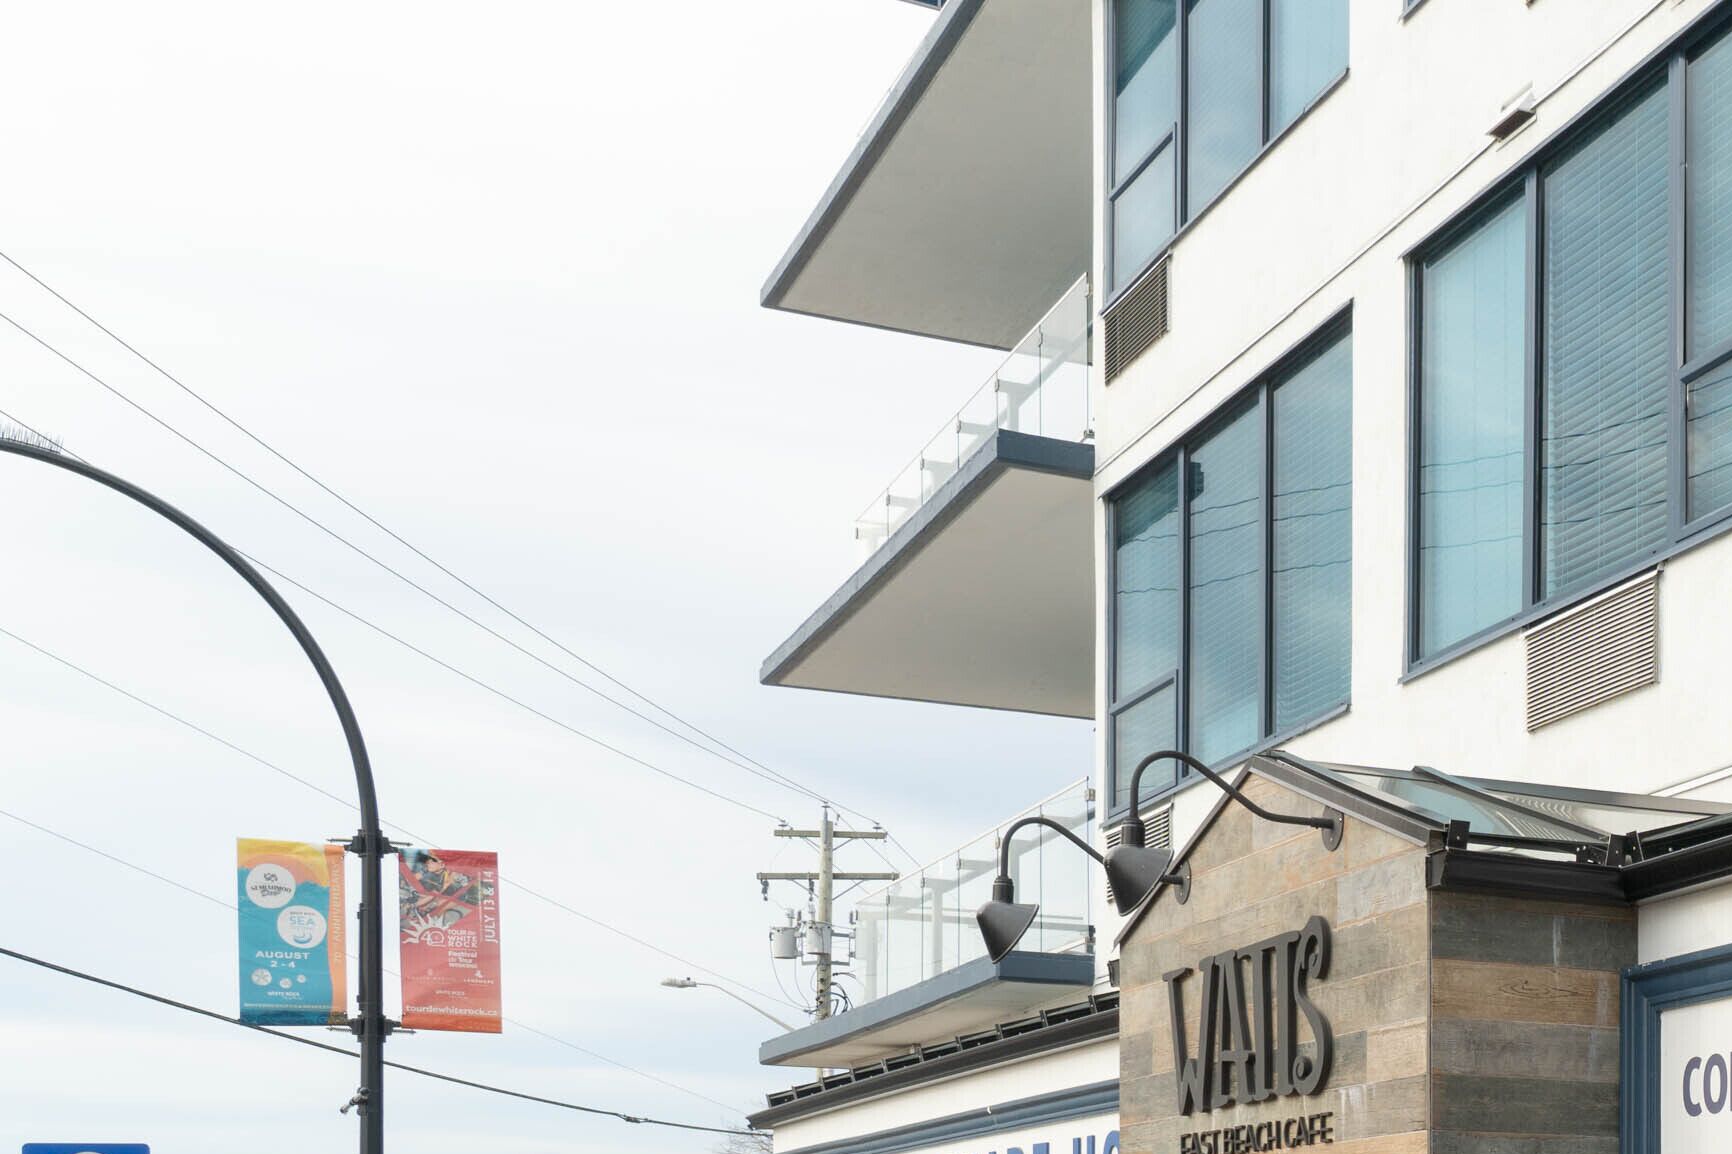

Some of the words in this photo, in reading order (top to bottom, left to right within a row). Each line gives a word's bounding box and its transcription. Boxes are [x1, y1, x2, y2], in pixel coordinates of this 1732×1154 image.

[483, 899, 495, 910] 13
[289, 916, 315, 926] SEA
[484, 915, 498, 944] JULY
[448, 940, 477, 948] ROCK
[255, 951, 311, 960] AUGUST
[1162, 915, 1333, 1116] WATTS
[1284, 1111, 1334, 1148] CAFE
